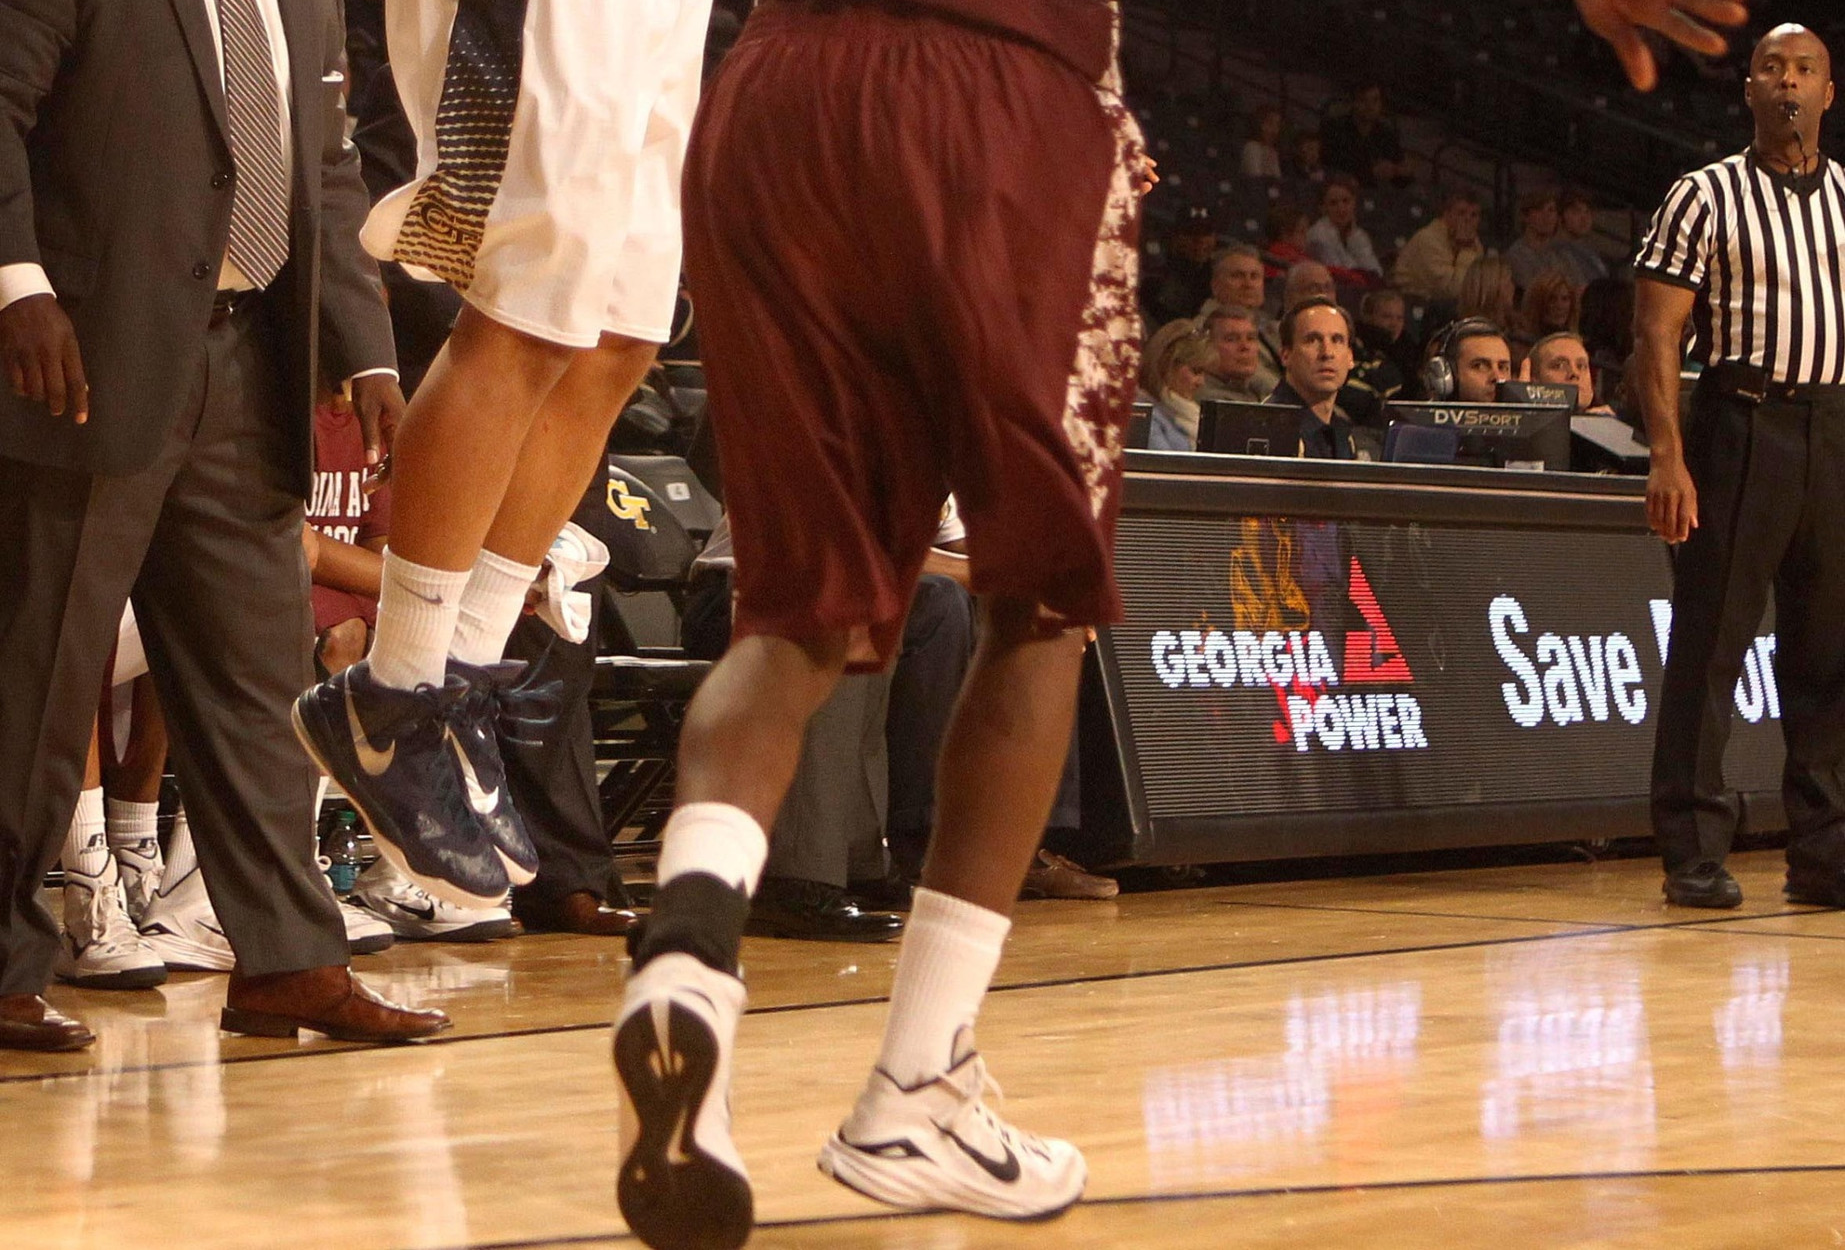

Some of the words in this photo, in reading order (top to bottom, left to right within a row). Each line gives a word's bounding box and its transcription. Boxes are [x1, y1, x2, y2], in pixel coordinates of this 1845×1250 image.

[1151, 631, 1339, 688] GEORGIA
[1488, 594, 1648, 727] Save
[1287, 694, 1428, 752] POWER
